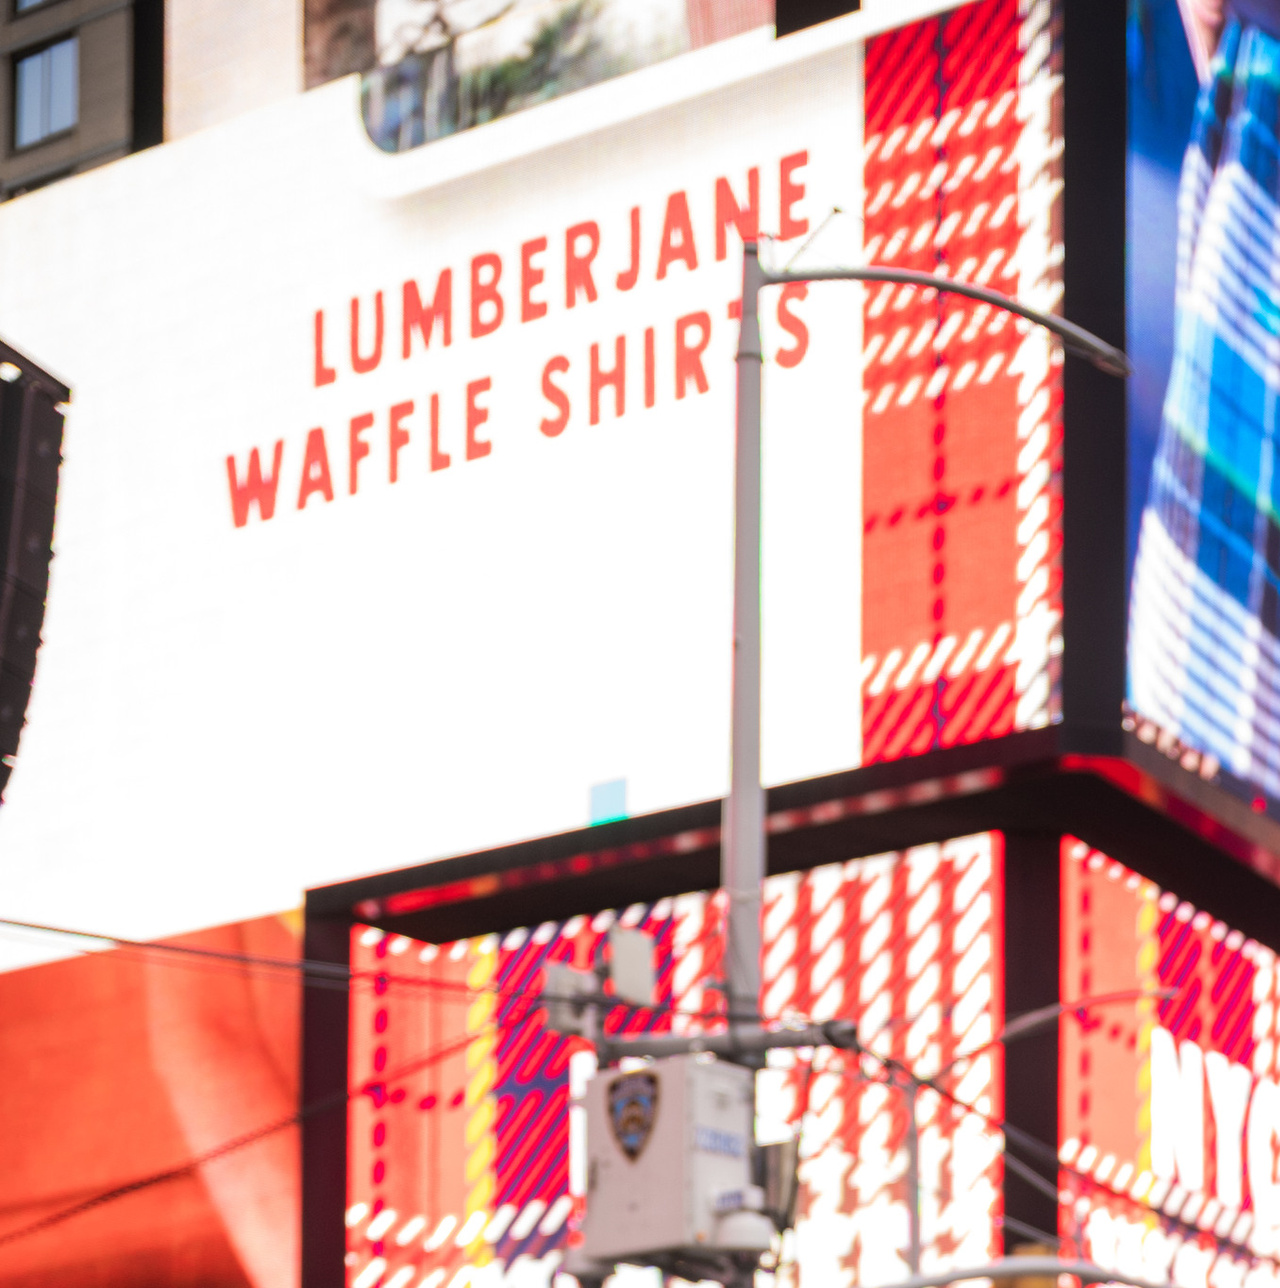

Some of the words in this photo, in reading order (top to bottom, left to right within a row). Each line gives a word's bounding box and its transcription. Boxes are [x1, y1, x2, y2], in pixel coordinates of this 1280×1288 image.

[313, 149, 811, 388] LUMBERJANE
[225, 376, 493, 528] WAFFLE
[539, 281, 811, 439] SHIRS
